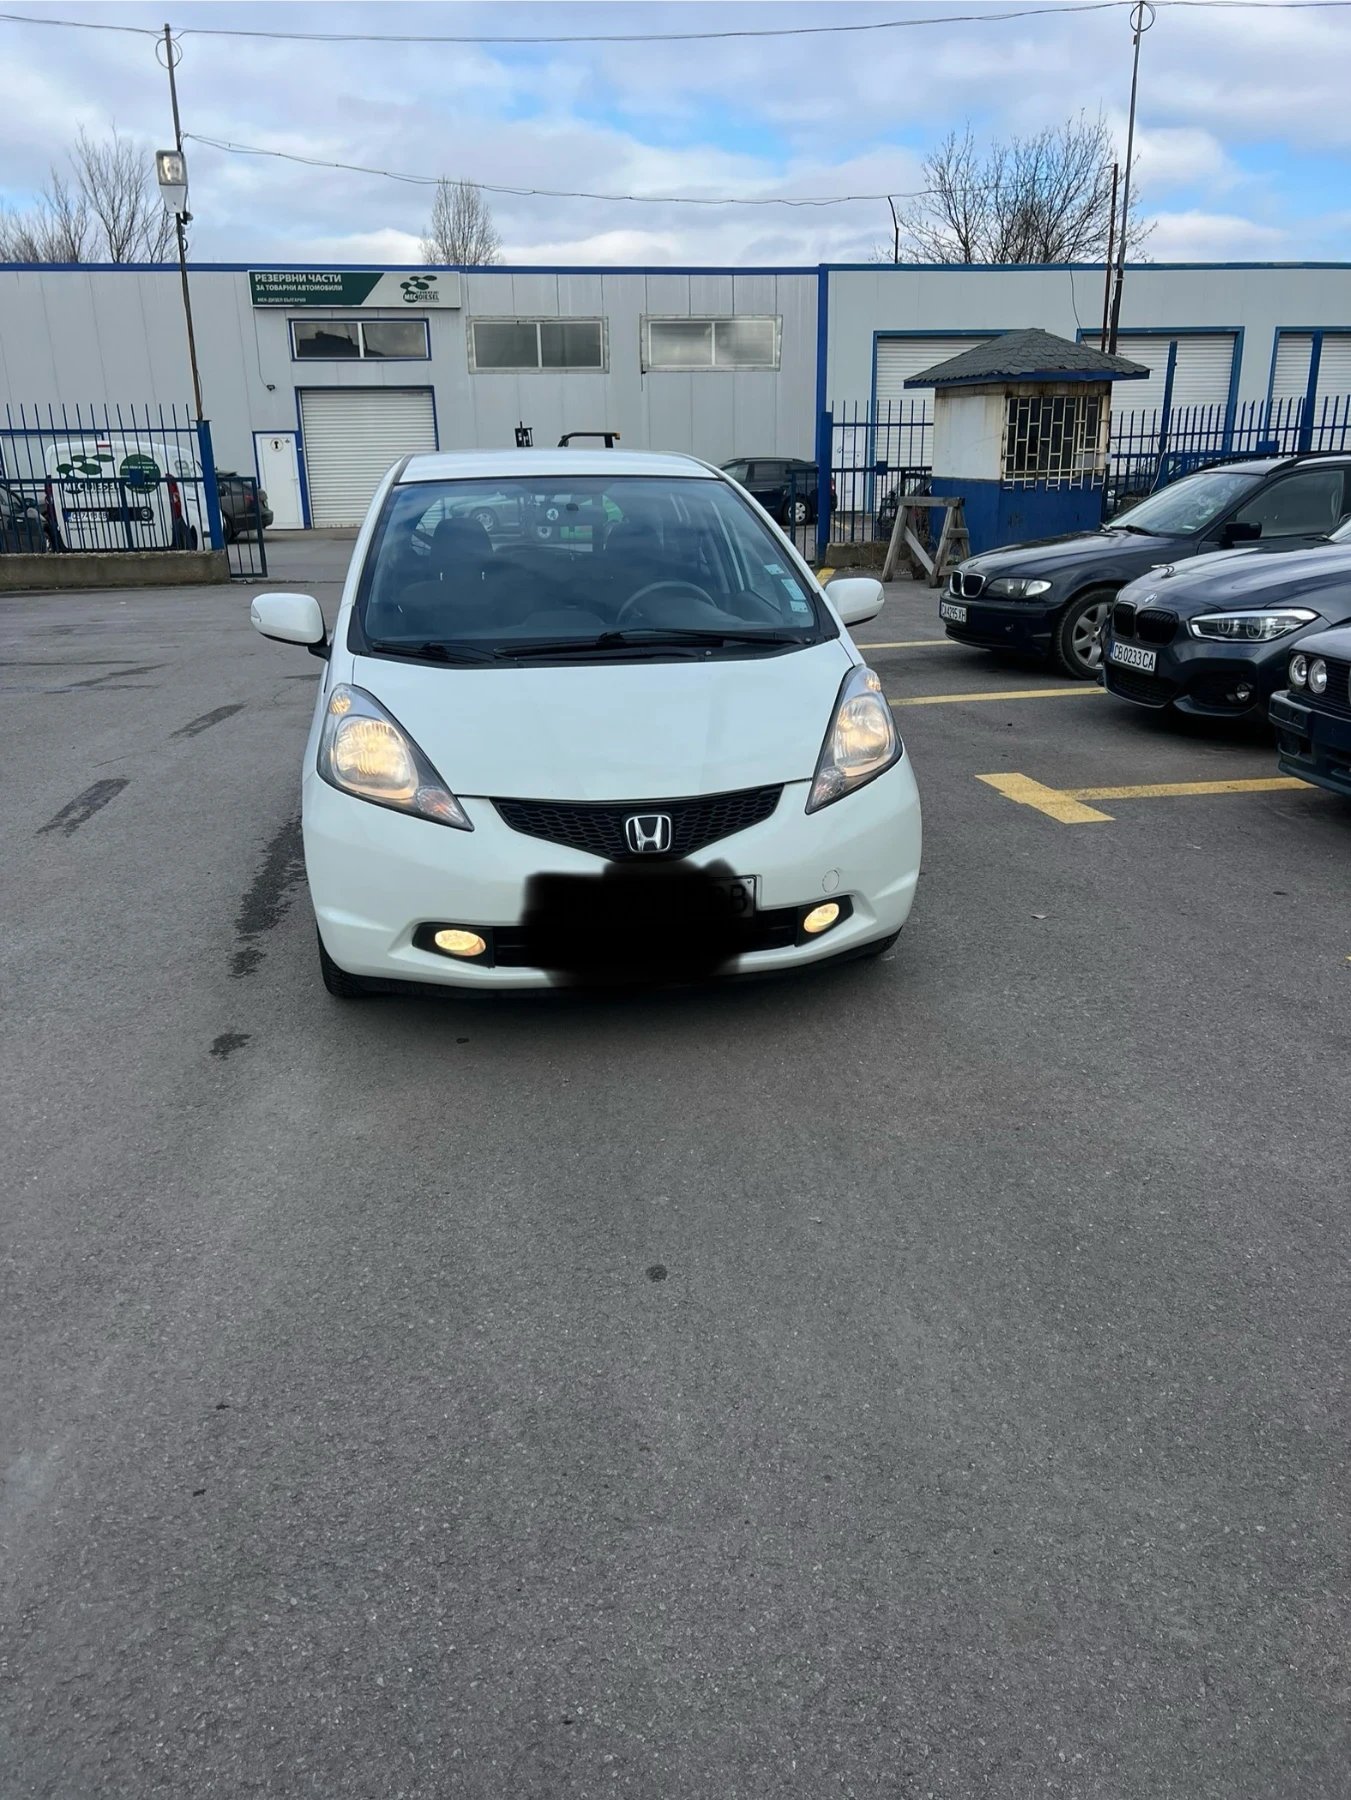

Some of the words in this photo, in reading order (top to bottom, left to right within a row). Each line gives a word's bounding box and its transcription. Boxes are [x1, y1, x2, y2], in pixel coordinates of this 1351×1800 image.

[254, 273, 307, 283] РЕЗЕРВНИ
[308, 273, 342, 283] ЧАСТИ
[1123, 647, 1142, 666] 0233
